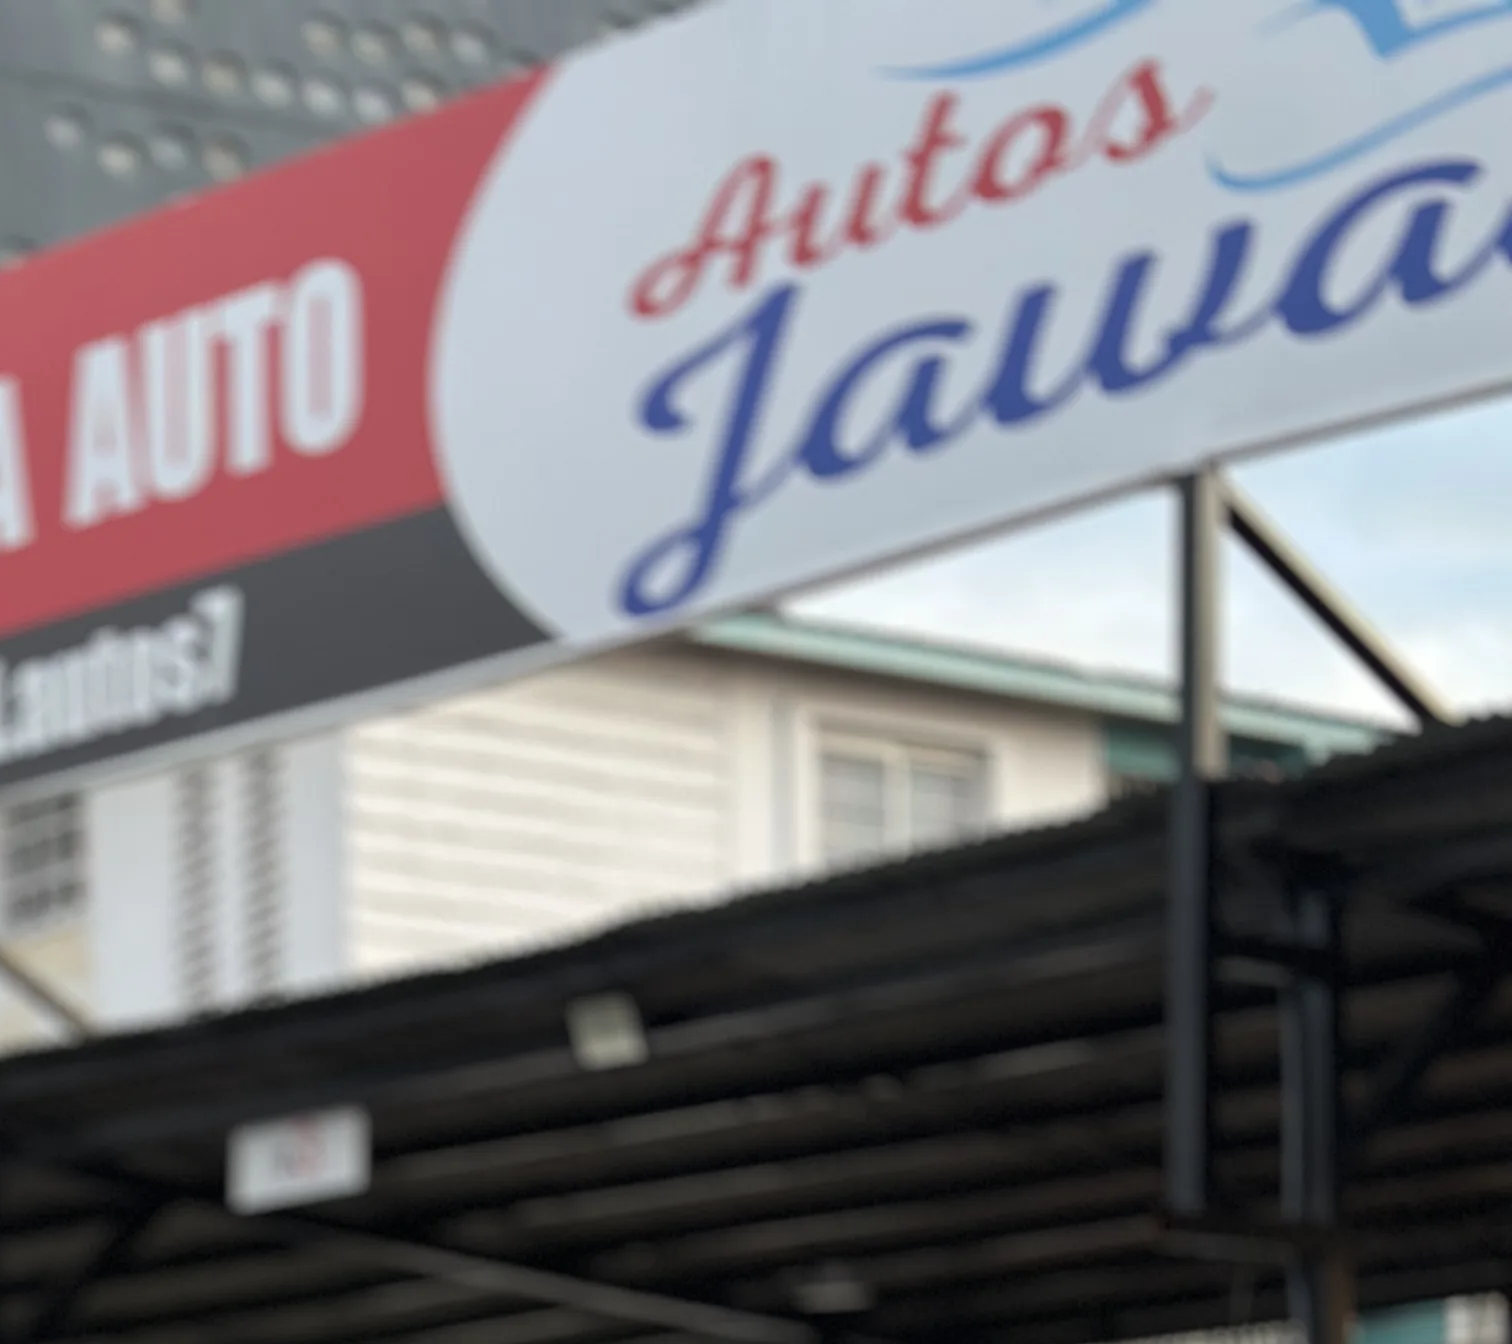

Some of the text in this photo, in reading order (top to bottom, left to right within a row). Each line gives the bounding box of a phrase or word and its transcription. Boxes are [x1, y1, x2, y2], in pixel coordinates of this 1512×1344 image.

[626, 60, 1214, 321] Autos
[61, 258, 365, 528] AUTO
[614, 160, 1512, 620] Jawa
